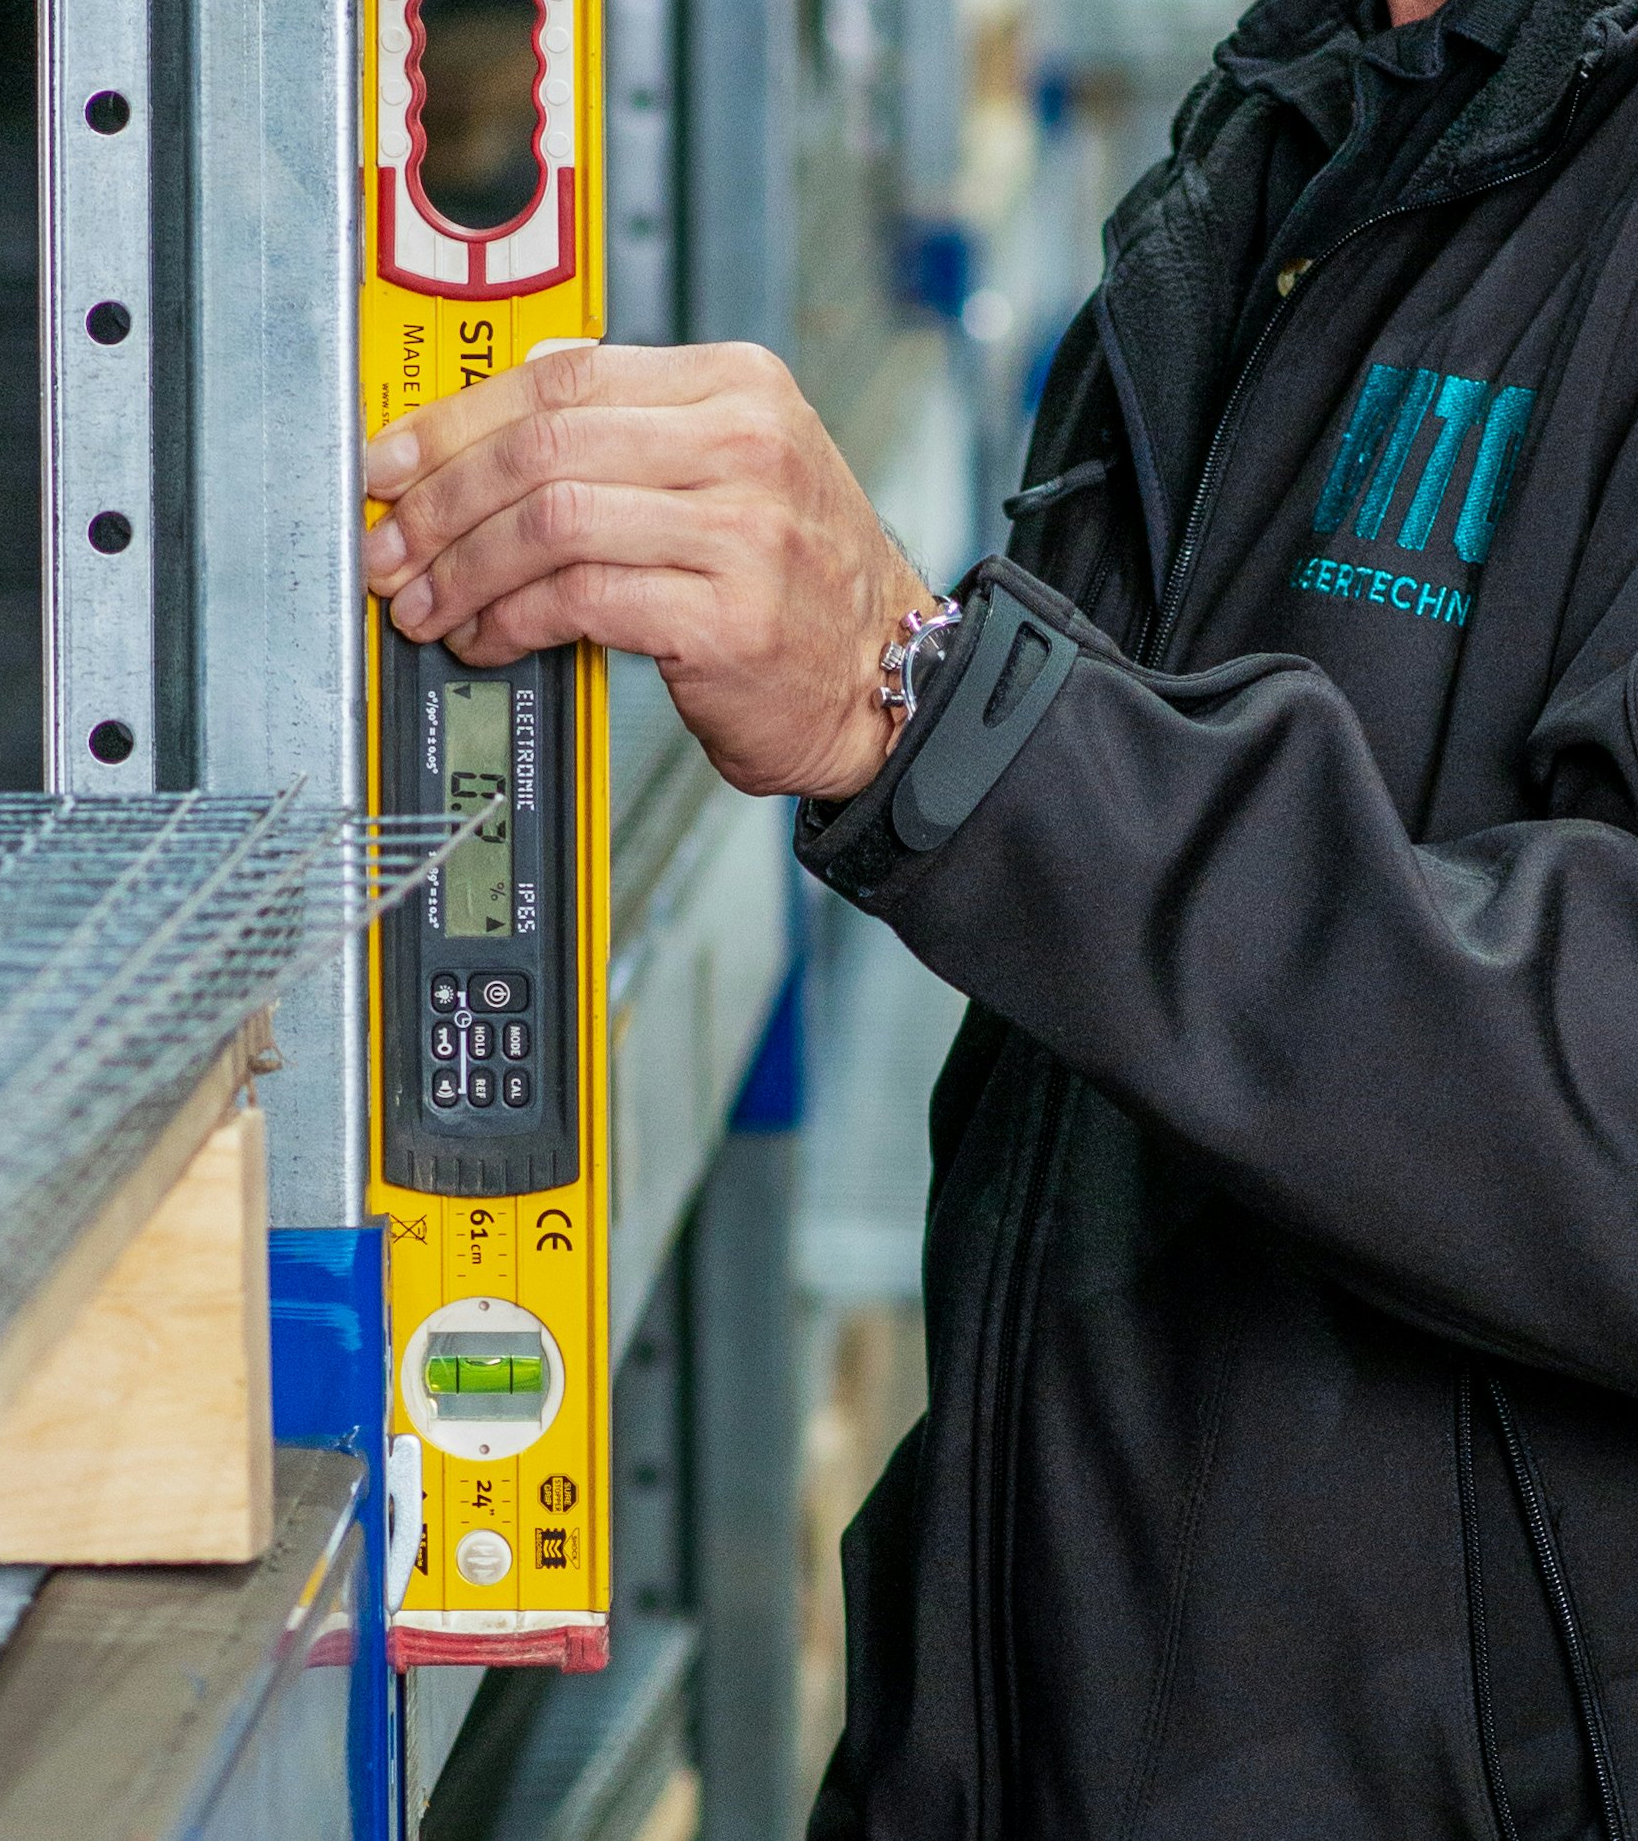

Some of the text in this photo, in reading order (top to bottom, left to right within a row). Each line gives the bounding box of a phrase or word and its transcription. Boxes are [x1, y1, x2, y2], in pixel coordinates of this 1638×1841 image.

[404, 324, 424, 392] MADE
[517, 690, 534, 810] ELECTRONIC
[490, 882, 505, 901] %
[518, 883, 535, 933] IP65
[475, 1026, 485, 1056] HOLD
[511, 1026, 520, 1056] MODE
[476, 1079, 485, 1098] REF
[511, 1078, 521, 1099] CAL
[470, 1209, 494, 1264] 61 cm
[537, 1209, 572, 1251] CE
[544, 1484, 552, 1505] GRIP
[554, 1479, 562, 1511] STOPPER
